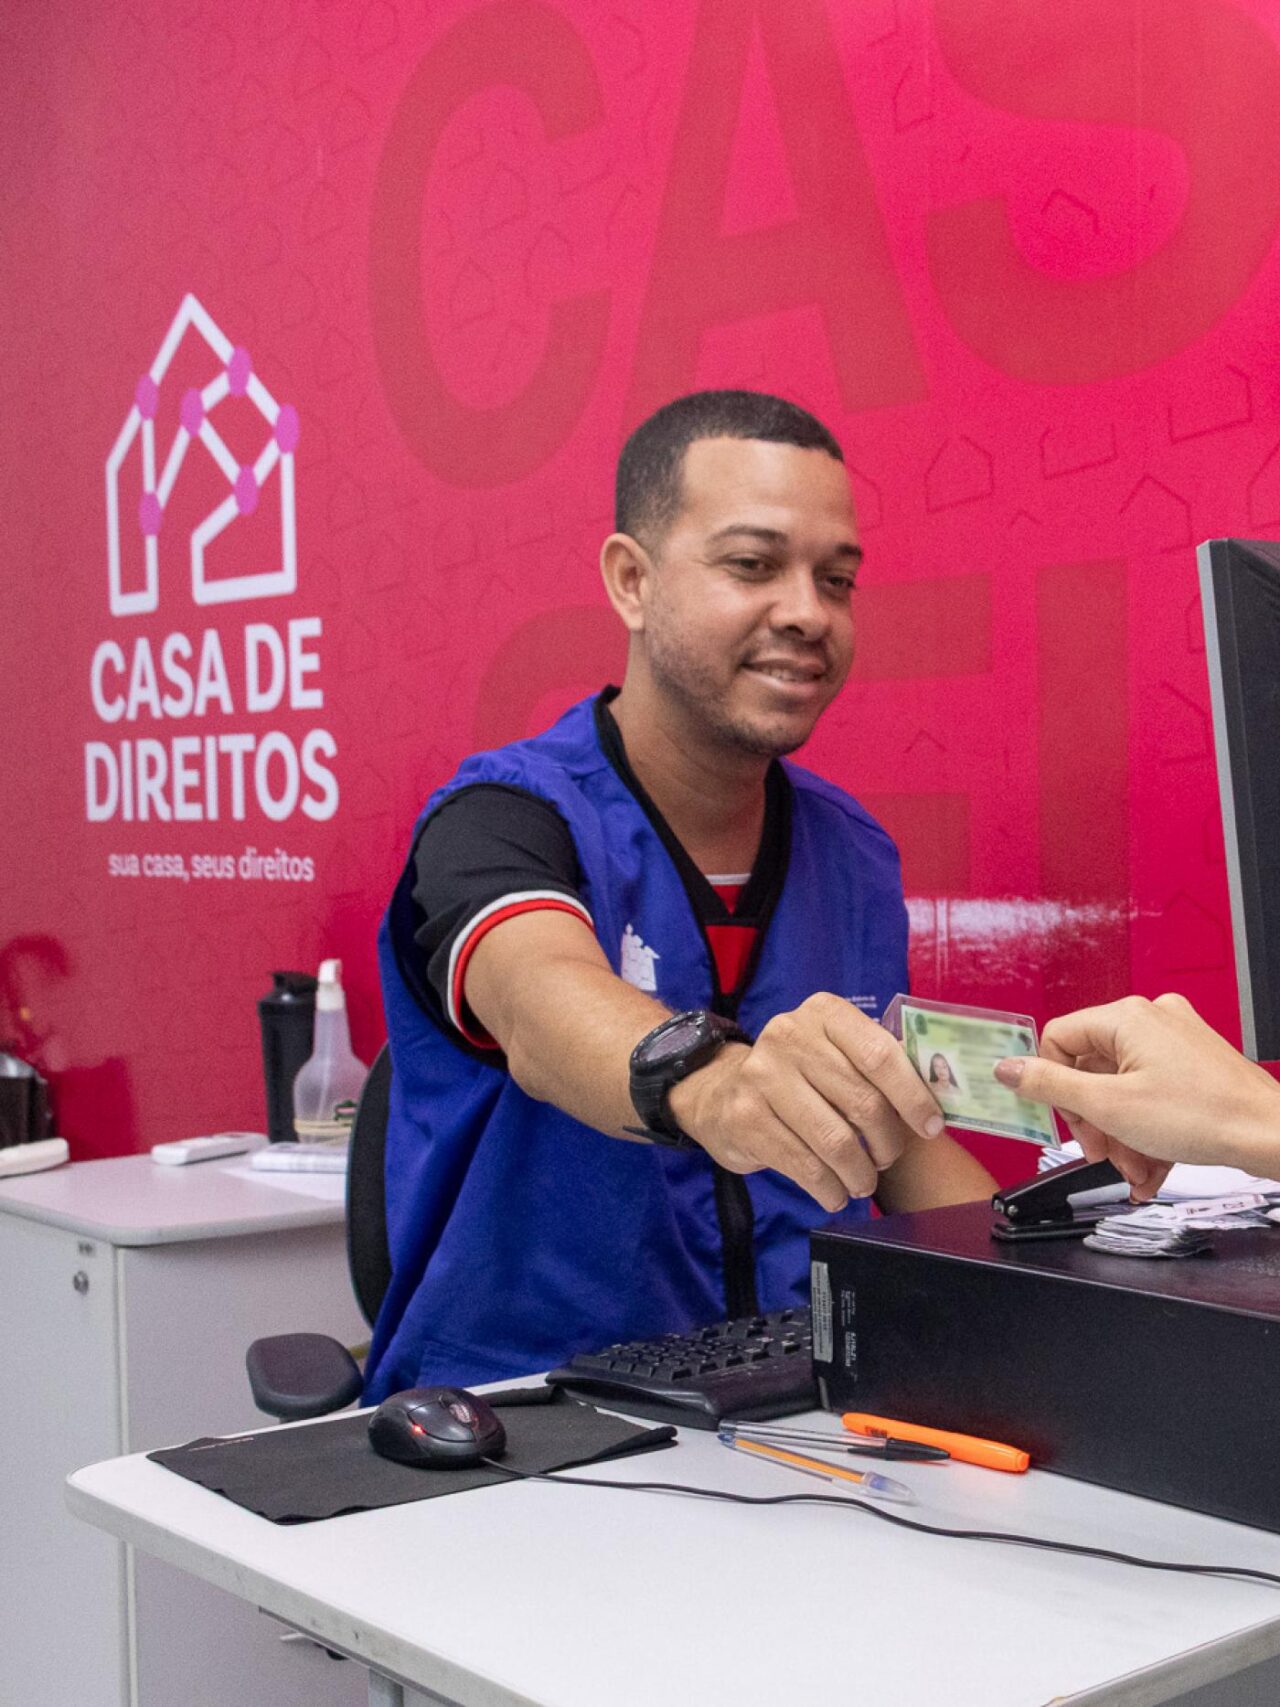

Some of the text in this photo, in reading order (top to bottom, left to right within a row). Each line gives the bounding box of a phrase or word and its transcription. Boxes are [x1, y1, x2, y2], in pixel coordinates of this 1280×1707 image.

[91, 617, 323, 723] CASA DE
[85, 728, 339, 822] DIREITOS
[108, 846, 315, 883] sua casa, seus direitos
